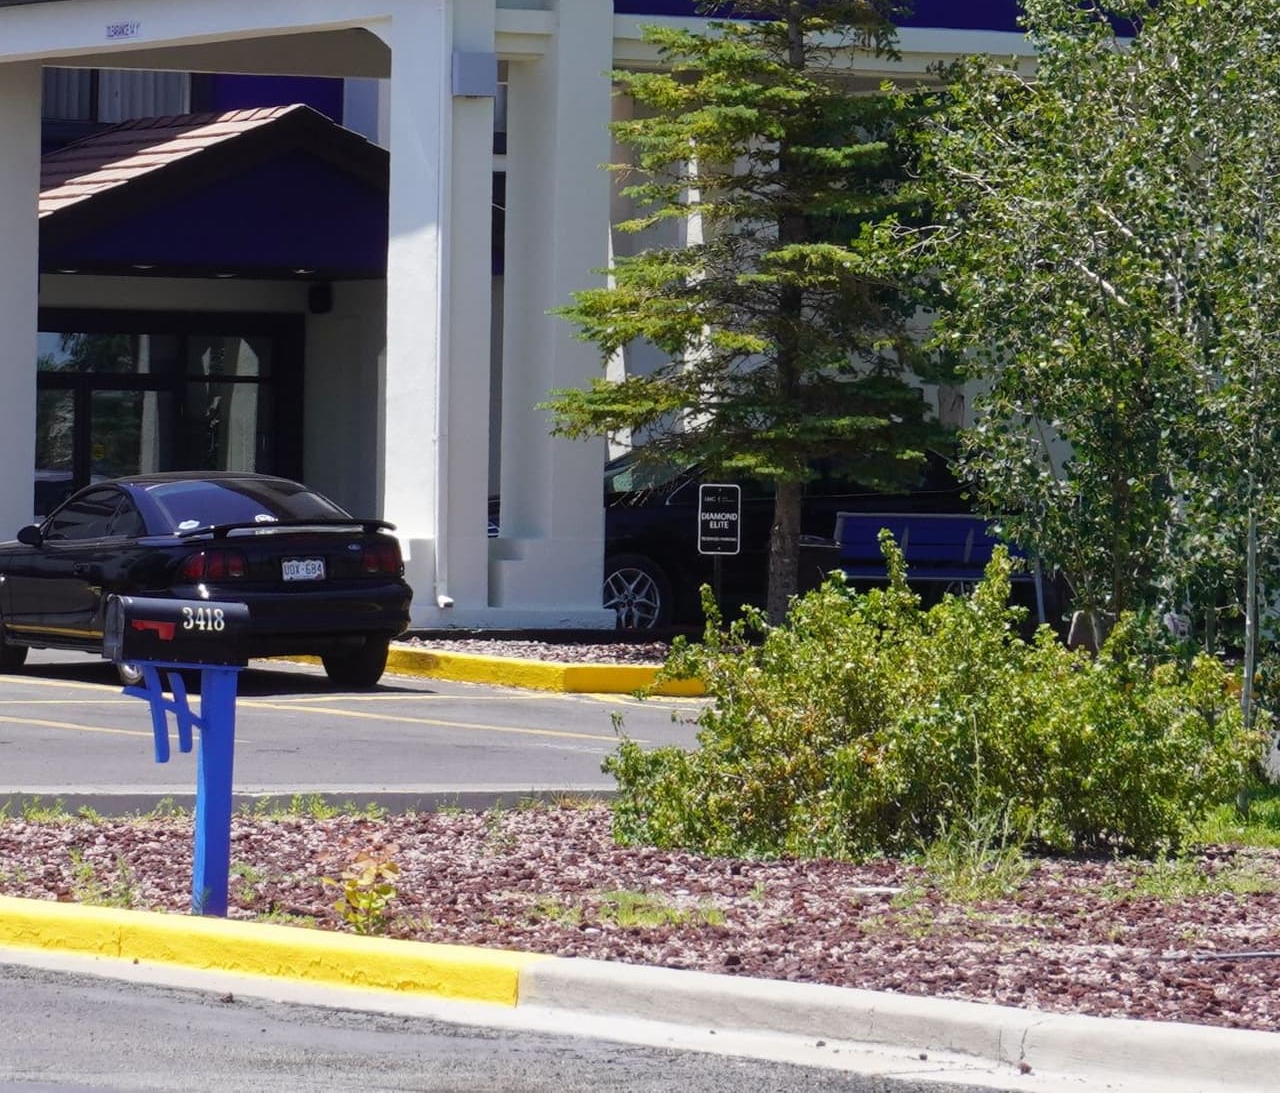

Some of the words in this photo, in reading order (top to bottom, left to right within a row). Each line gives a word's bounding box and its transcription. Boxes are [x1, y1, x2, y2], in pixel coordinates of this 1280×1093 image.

[701, 512, 738, 521] DIAMOND
[709, 520, 729, 529] ELITE
[182, 607, 225, 631] 3418
